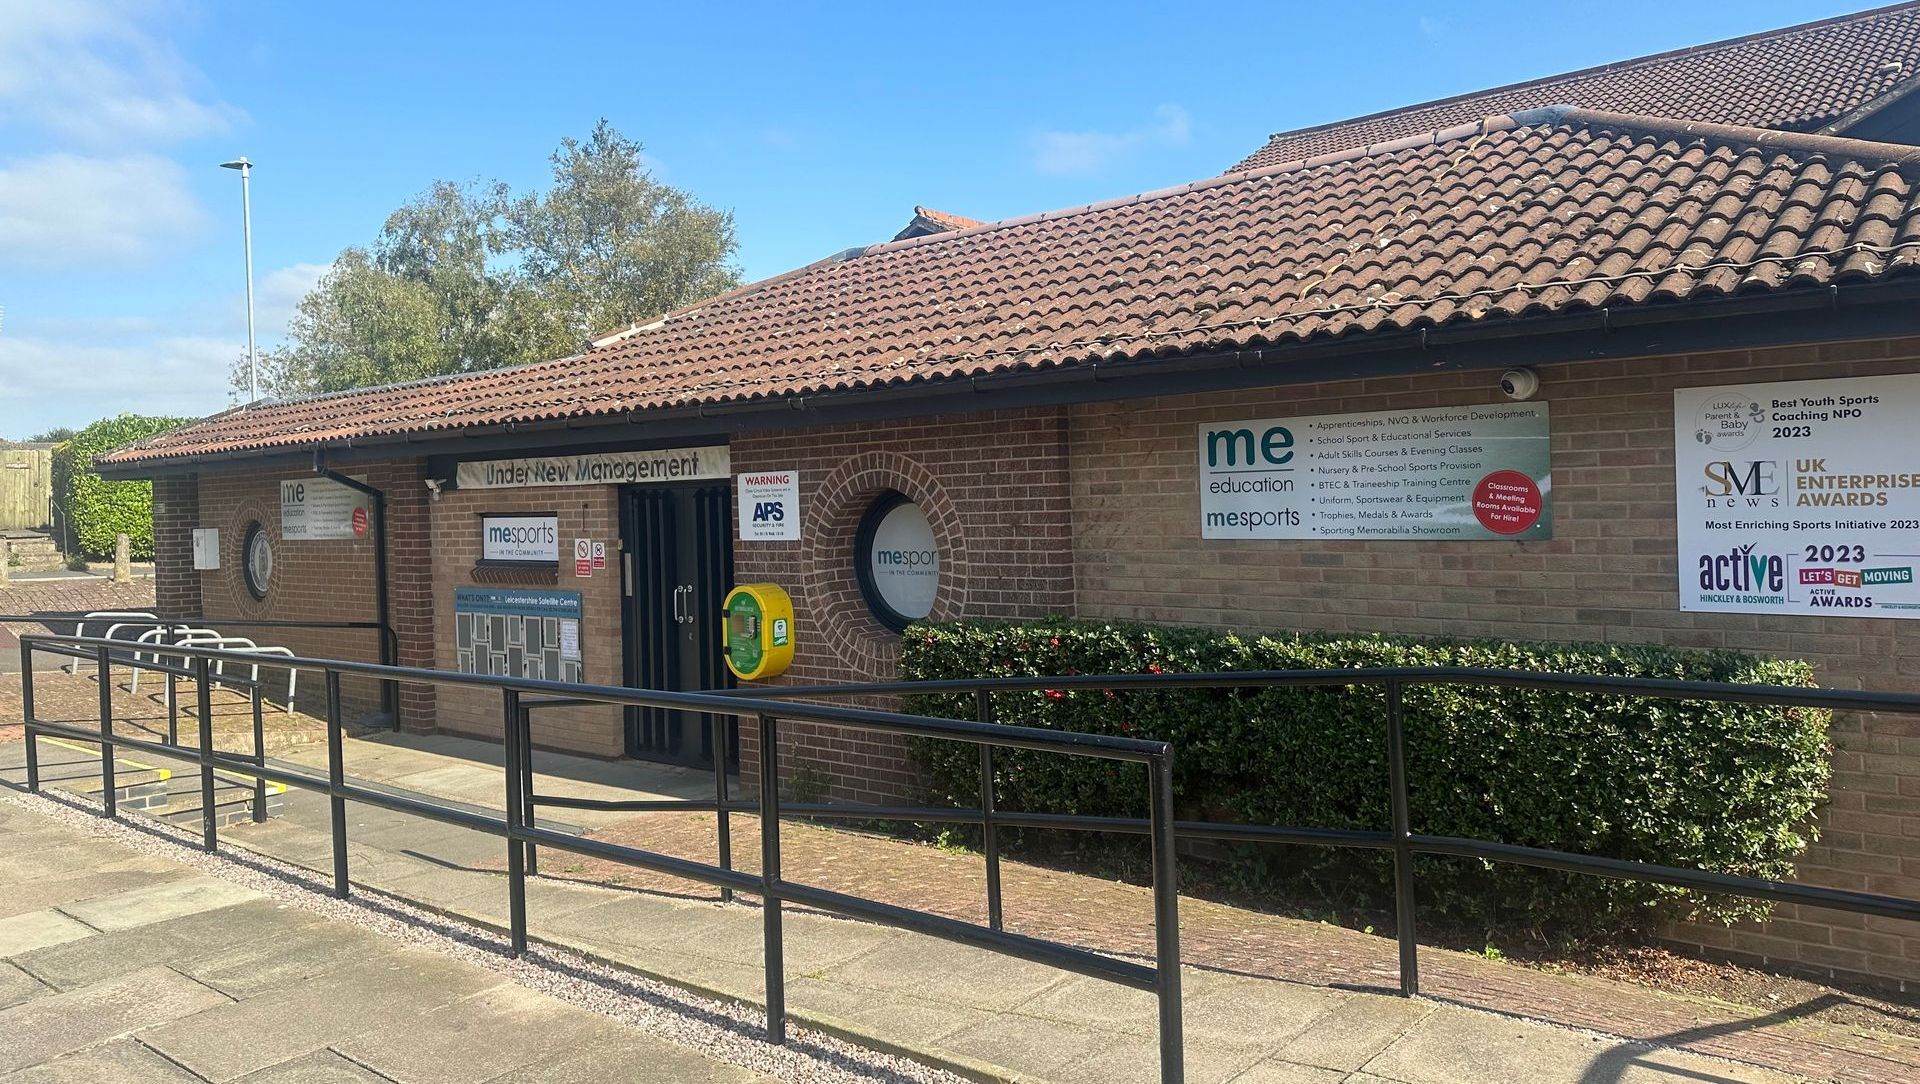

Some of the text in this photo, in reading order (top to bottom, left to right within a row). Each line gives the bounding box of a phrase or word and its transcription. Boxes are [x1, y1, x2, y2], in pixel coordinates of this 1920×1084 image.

[1772, 395, 1879, 408] Best Youth Sports
[1317, 410, 1535, 431] Apprenticeships, NVQ & Workforce Development
[1705, 412, 1732, 420] Parent
[1772, 409, 1862, 421] Coaching NPO
[1721, 420, 1749, 430] Baby
[1317, 430, 1471, 444] School Sport & Educational Services
[1772, 426, 1811, 438] 2023
[1207, 426, 1294, 467] me
[1318, 445, 1482, 459] Adult Skills Courses & Evening Classes
[486, 452, 699, 485] Under New Management
[1318, 461, 1481, 475] Nursery & Pre-School Sports Provision
[1796, 459, 1827, 472] UK
[745, 475, 789, 485] WARNING
[1209, 477, 1294, 493] education
[1319, 481, 1341, 489] BTEC
[1352, 480, 1400, 489] Traineeship
[1402, 479, 1437, 488] Training
[1440, 478, 1471, 486] Centre
[1703, 461, 1780, 496] SME
[1796, 473, 1920, 489] ENTERPRISE
[282, 483, 304, 503] me
[1487, 482, 1529, 492] Classrooms
[1319, 494, 1465, 505] Uniform, Sportswear & Equipment
[1496, 493, 1525, 504] Meeting
[1706, 498, 1779, 508] news
[1796, 491, 1888, 506] AWARDS
[753, 502, 784, 521] APS
[1477, 502, 1536, 514] Rooms Available
[1207, 508, 1300, 531] mesports
[1320, 510, 1433, 520] Trophies, Medals & Awards
[1503, 514, 1519, 522] Hire!
[1320, 525, 1460, 536] Sporting Memorabilia Showroom
[1705, 520, 1919, 531] Most Enriching Sports Initiative 2023
[489, 522, 554, 548] mesports
[878, 551, 937, 568] mespor
[1805, 544, 1865, 563] 2023
[1700, 543, 1783, 593] active
[1802, 570, 1909, 585] LET'S GET MOVING
[504, 596, 538, 605] Leicestershire
[538, 597, 558, 606] Satellite
[559, 598, 578, 606] Centre
[1700, 594, 1784, 605] HINCKLEY & BOSWORTH
[1810, 596, 1873, 608] AWARDS
